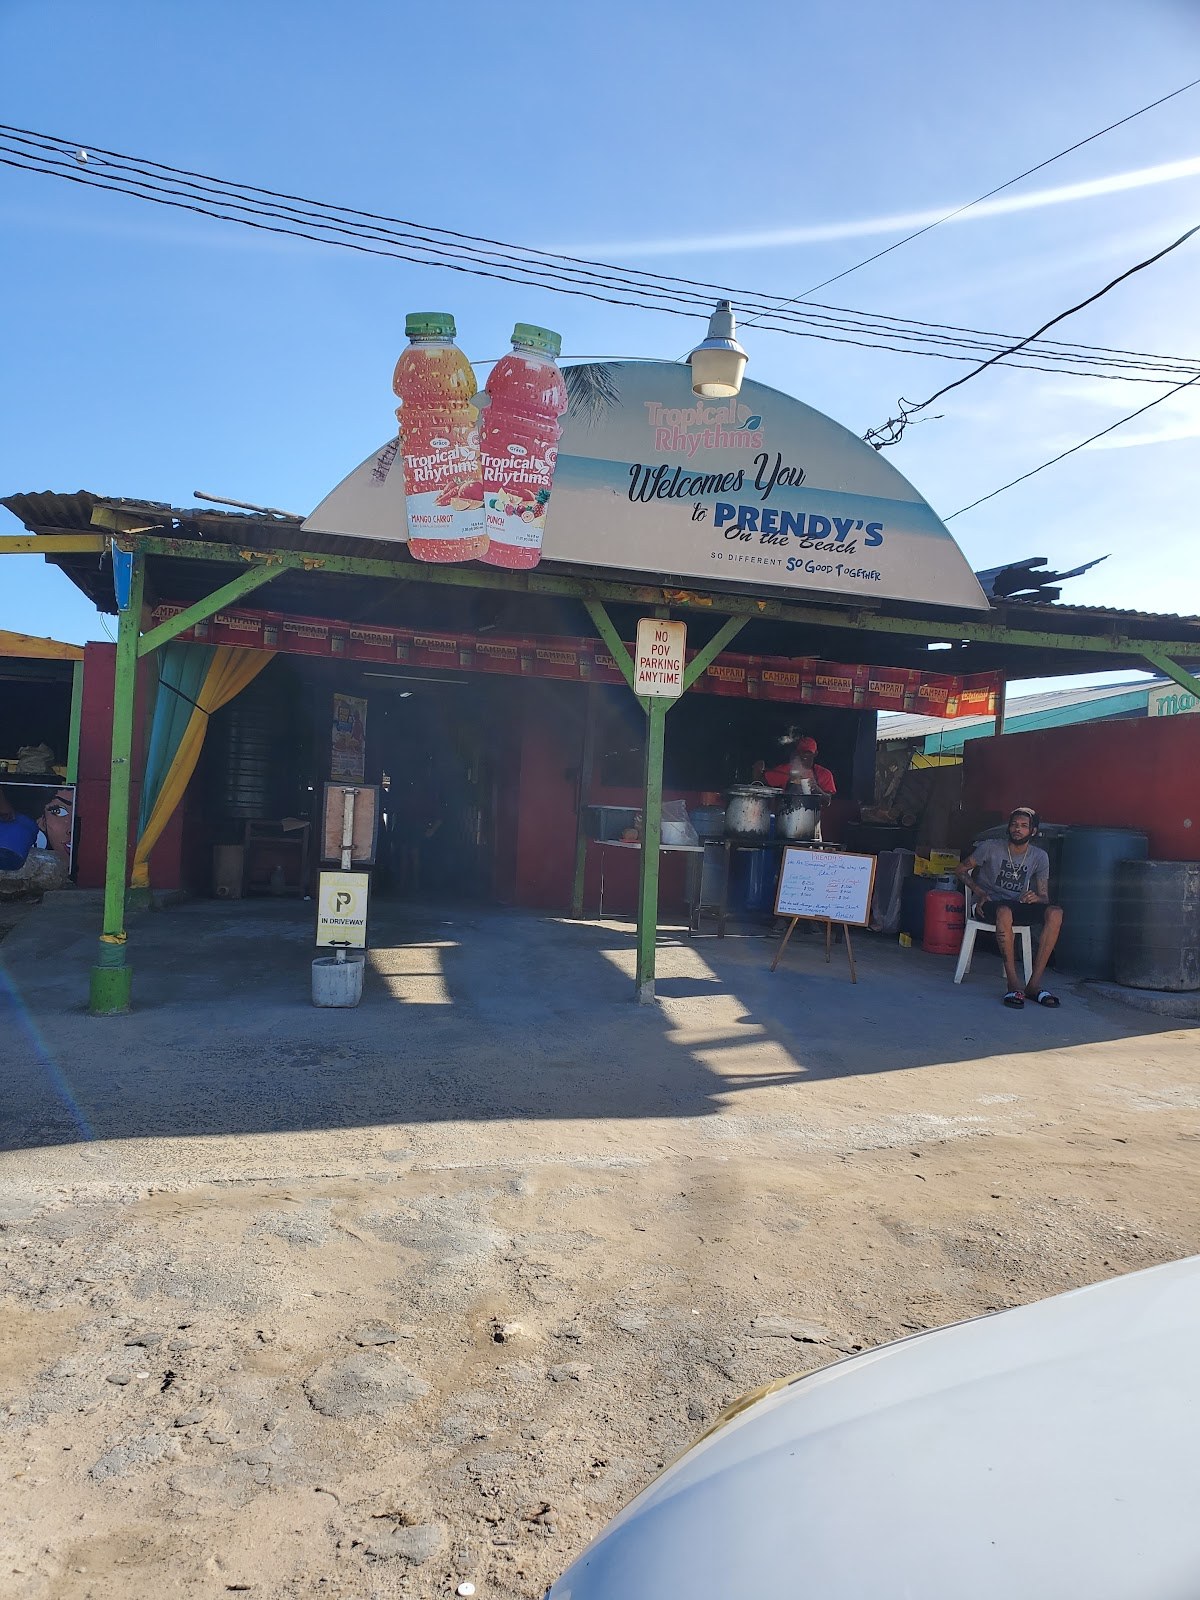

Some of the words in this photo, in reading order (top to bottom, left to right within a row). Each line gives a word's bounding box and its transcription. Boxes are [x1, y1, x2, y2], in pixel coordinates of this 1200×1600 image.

[644, 399, 737, 432] Tropical
[655, 425, 764, 458] Rhythms
[404, 444, 460, 469] Tropical
[481, 453, 535, 472] Tropical
[414, 460, 478, 483] Rhythms
[484, 468, 549, 486] Rhythms
[629, 464, 745, 502] Welcomes
[754, 453, 806, 500] You
[411, 514, 431, 523] MANGO
[433, 514, 454, 523] CARROT
[487, 515, 505, 526] PUNCH
[692, 502, 708, 522] to
[714, 503, 884, 546] PRENDY'S
[724, 524, 753, 542] On
[760, 531, 789, 547] the
[799, 533, 857, 555] Beach
[711, 552, 723, 560] SO
[728, 554, 782, 566] DIFFERENT
[284, 623, 328, 636] CAMPARI
[351, 631, 393, 643] CAMPARI
[654, 630, 668, 643] NO
[415, 638, 456, 650] CAMPARI
[477, 644, 516, 656] CAMPARI
[651, 644, 671, 656] POV
[538, 651, 575, 662] CAMPARI
[639, 657, 680, 671] PARKING
[638, 671, 680, 685] ANYTIME
[708, 666, 744, 678] CAMPARI
[763, 671, 798, 683] CAMPARI
[816, 677, 852, 689] CAMPARI
[870, 681, 902, 694] CAMPARI
[919, 687, 948, 699] CAMPARI
[1000, 879, 1024, 891] york
[336, 892, 352, 912] P
[330, 918, 364, 926] DRIVEWAY
